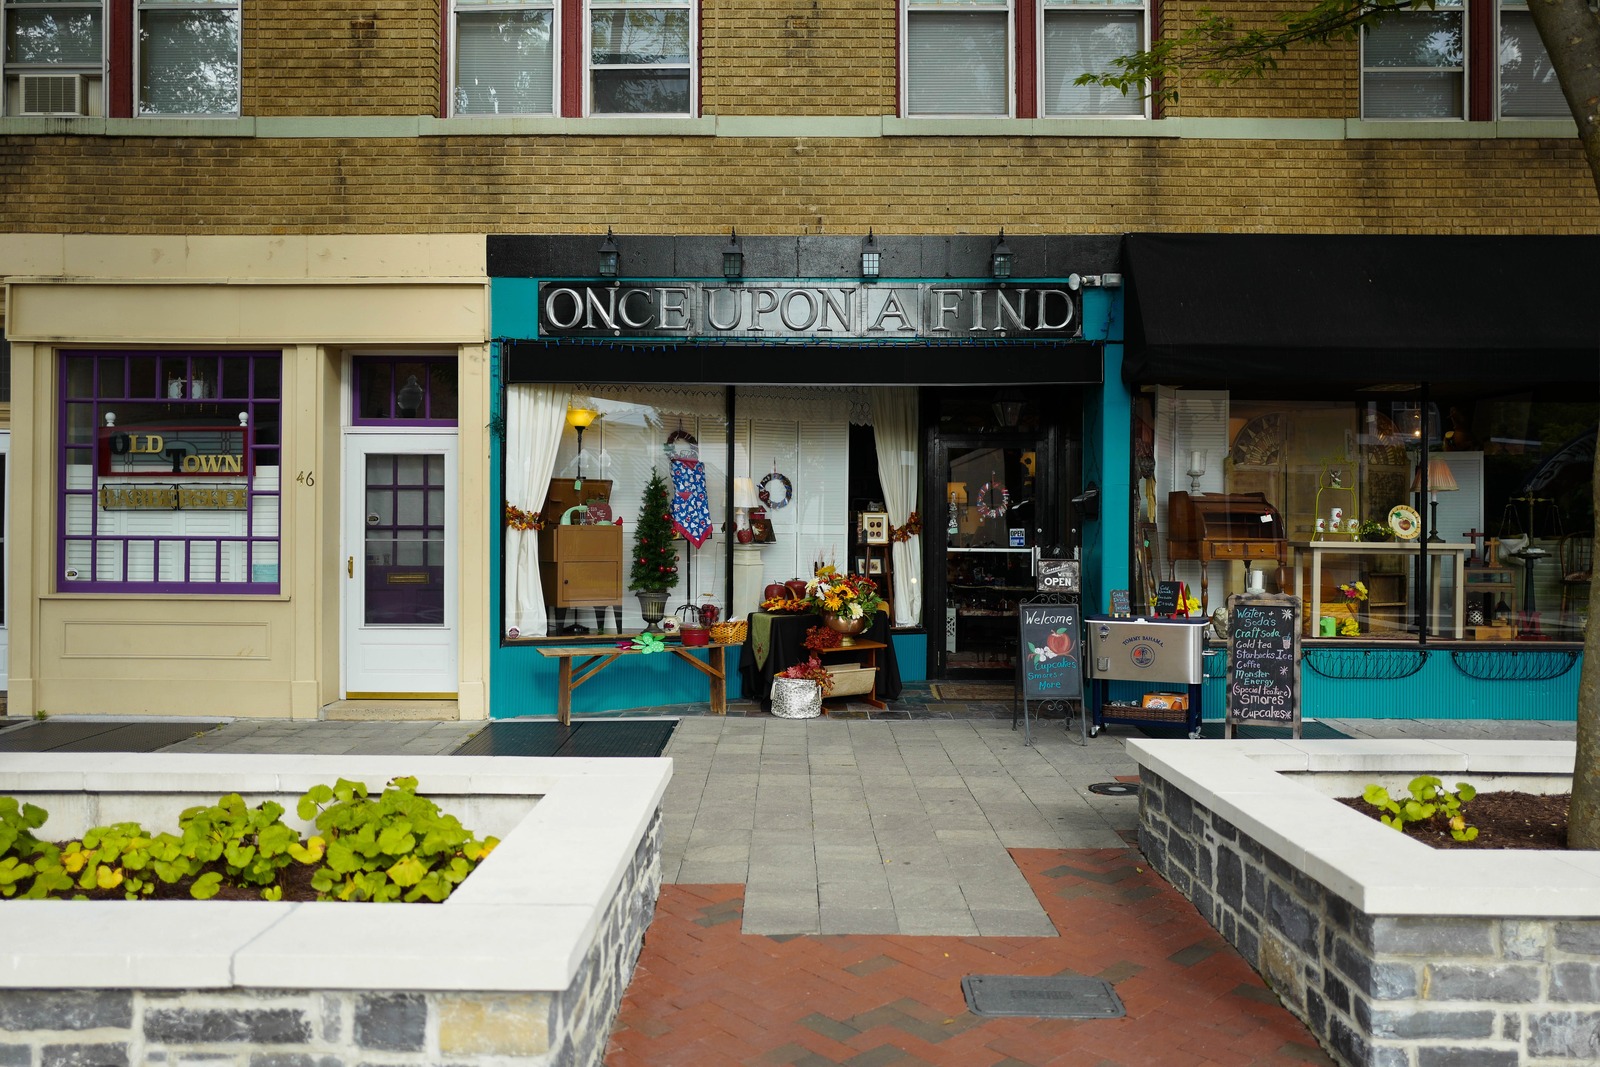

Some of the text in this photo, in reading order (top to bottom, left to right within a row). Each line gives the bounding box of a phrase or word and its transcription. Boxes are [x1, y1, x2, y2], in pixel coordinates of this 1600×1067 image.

[545, 286, 1074, 331] ONCE UPON A FIND
[110, 431, 164, 455] OLD
[165, 448, 243, 473] TOWN
[296, 471, 315, 487] 46
[1044, 577, 1071, 587] OPEN
[1025, 610, 1073, 626] Welcome
[1236, 607, 1265, 618] Water
[1244, 616, 1277, 627] Soda's
[1235, 627, 1260, 638] Craft
[1122, 635, 1141, 646] TOMMY
[1142, 635, 1164, 648] BAHAMA
[1235, 639, 1272, 649] Cold tea
[1236, 649, 1293, 660] Starbucks Ice
[1034, 657, 1077, 673] Cupcakes
[1236, 660, 1261, 669] Coffee
[1027, 672, 1058, 681] Smores
[1235, 669, 1270, 679] Monster
[1039, 680, 1061, 691] More
[1243, 678, 1274, 687] Energy
[1239, 694, 1284, 705] Smores
[1241, 706, 1286, 719] Cupcakes
